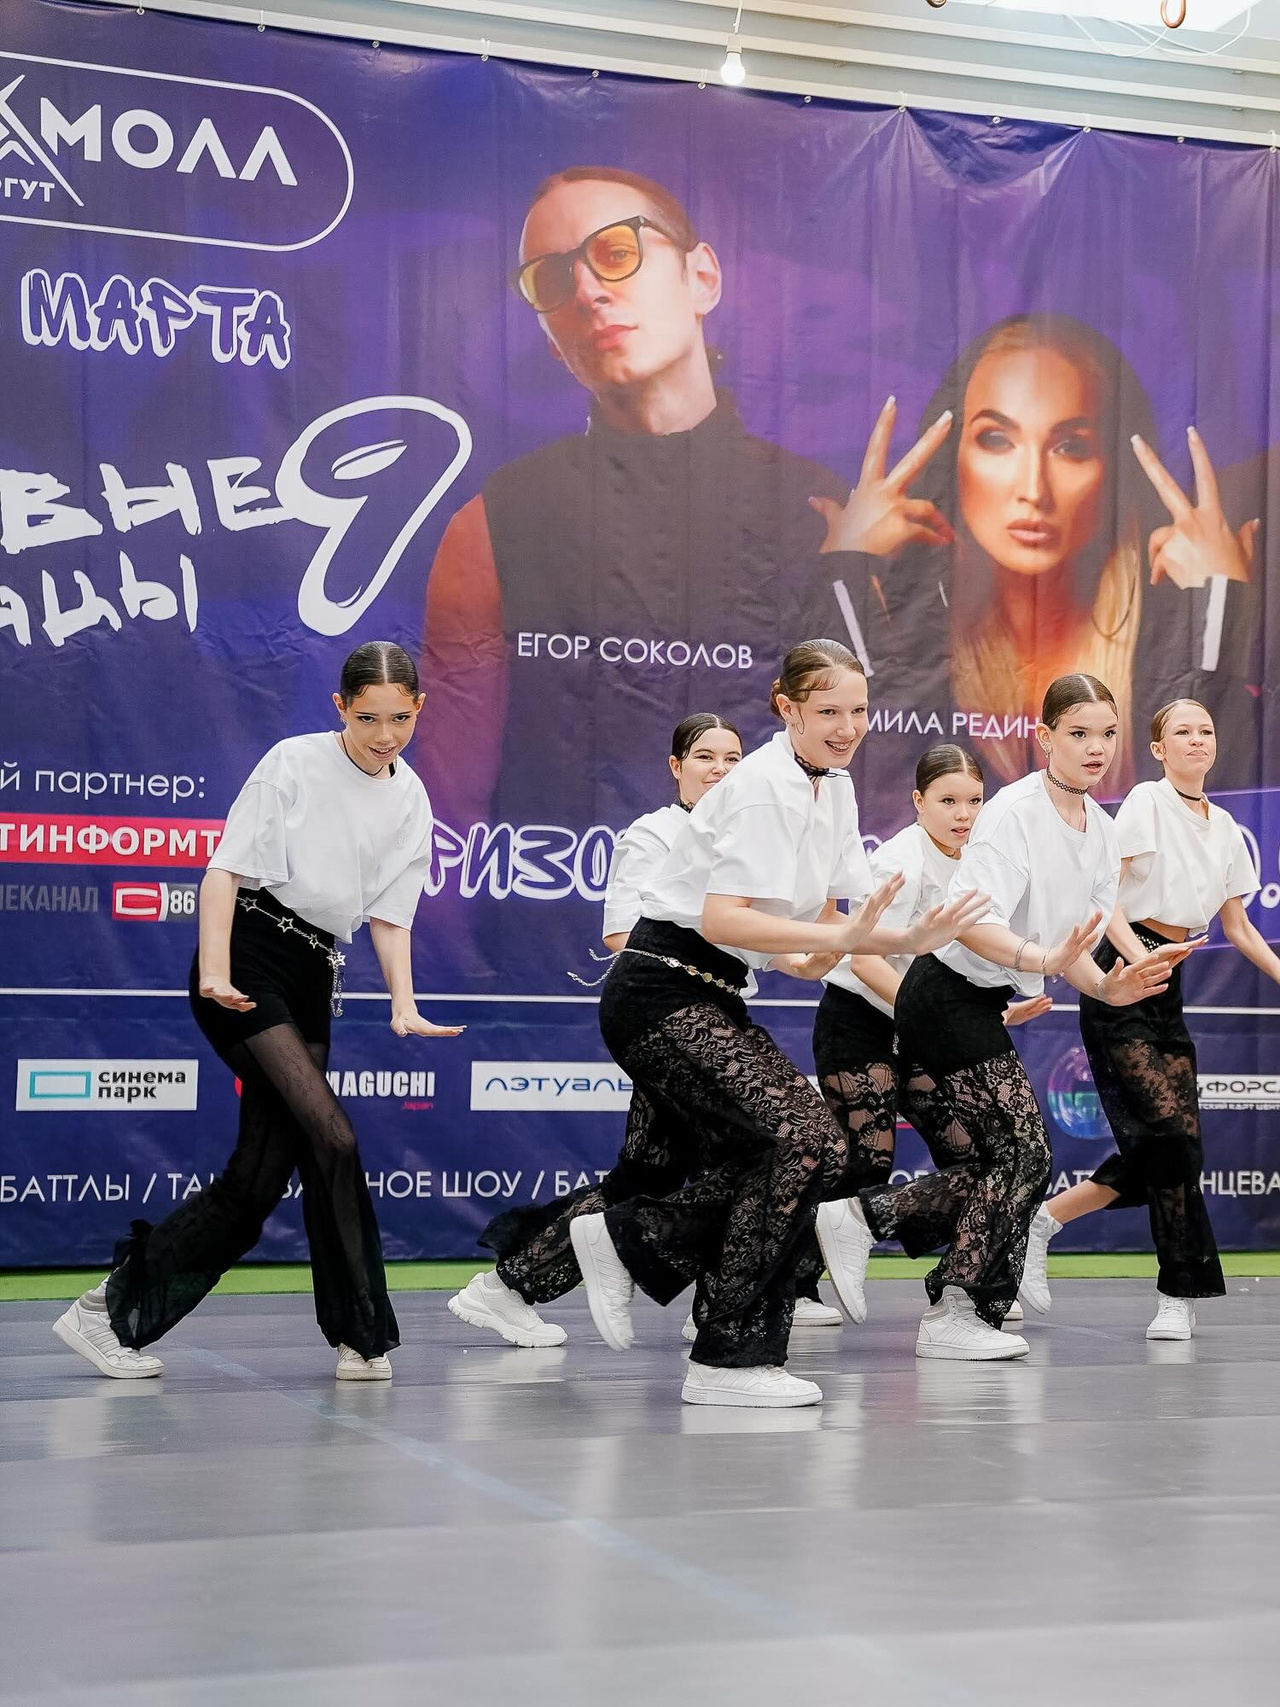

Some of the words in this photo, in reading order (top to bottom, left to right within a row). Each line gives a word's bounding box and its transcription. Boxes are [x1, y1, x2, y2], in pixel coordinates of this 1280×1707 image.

[41, 97, 298, 186] МОЛЛ
[0, 177, 55, 203] ГУТ
[21, 268, 291, 370] МАРТА
[517, 633, 590, 662] ЕГОР
[600, 637, 753, 669] СОКОЛОВ
[35, 769, 205, 804] партнер:
[423, 817, 628, 902] РИЗО
[0, 883, 99, 913] ЕКАНАЛ
[0, 1173, 131, 1203] БАТТЛЫ
[442, 1170, 523, 1199] ШОУ
